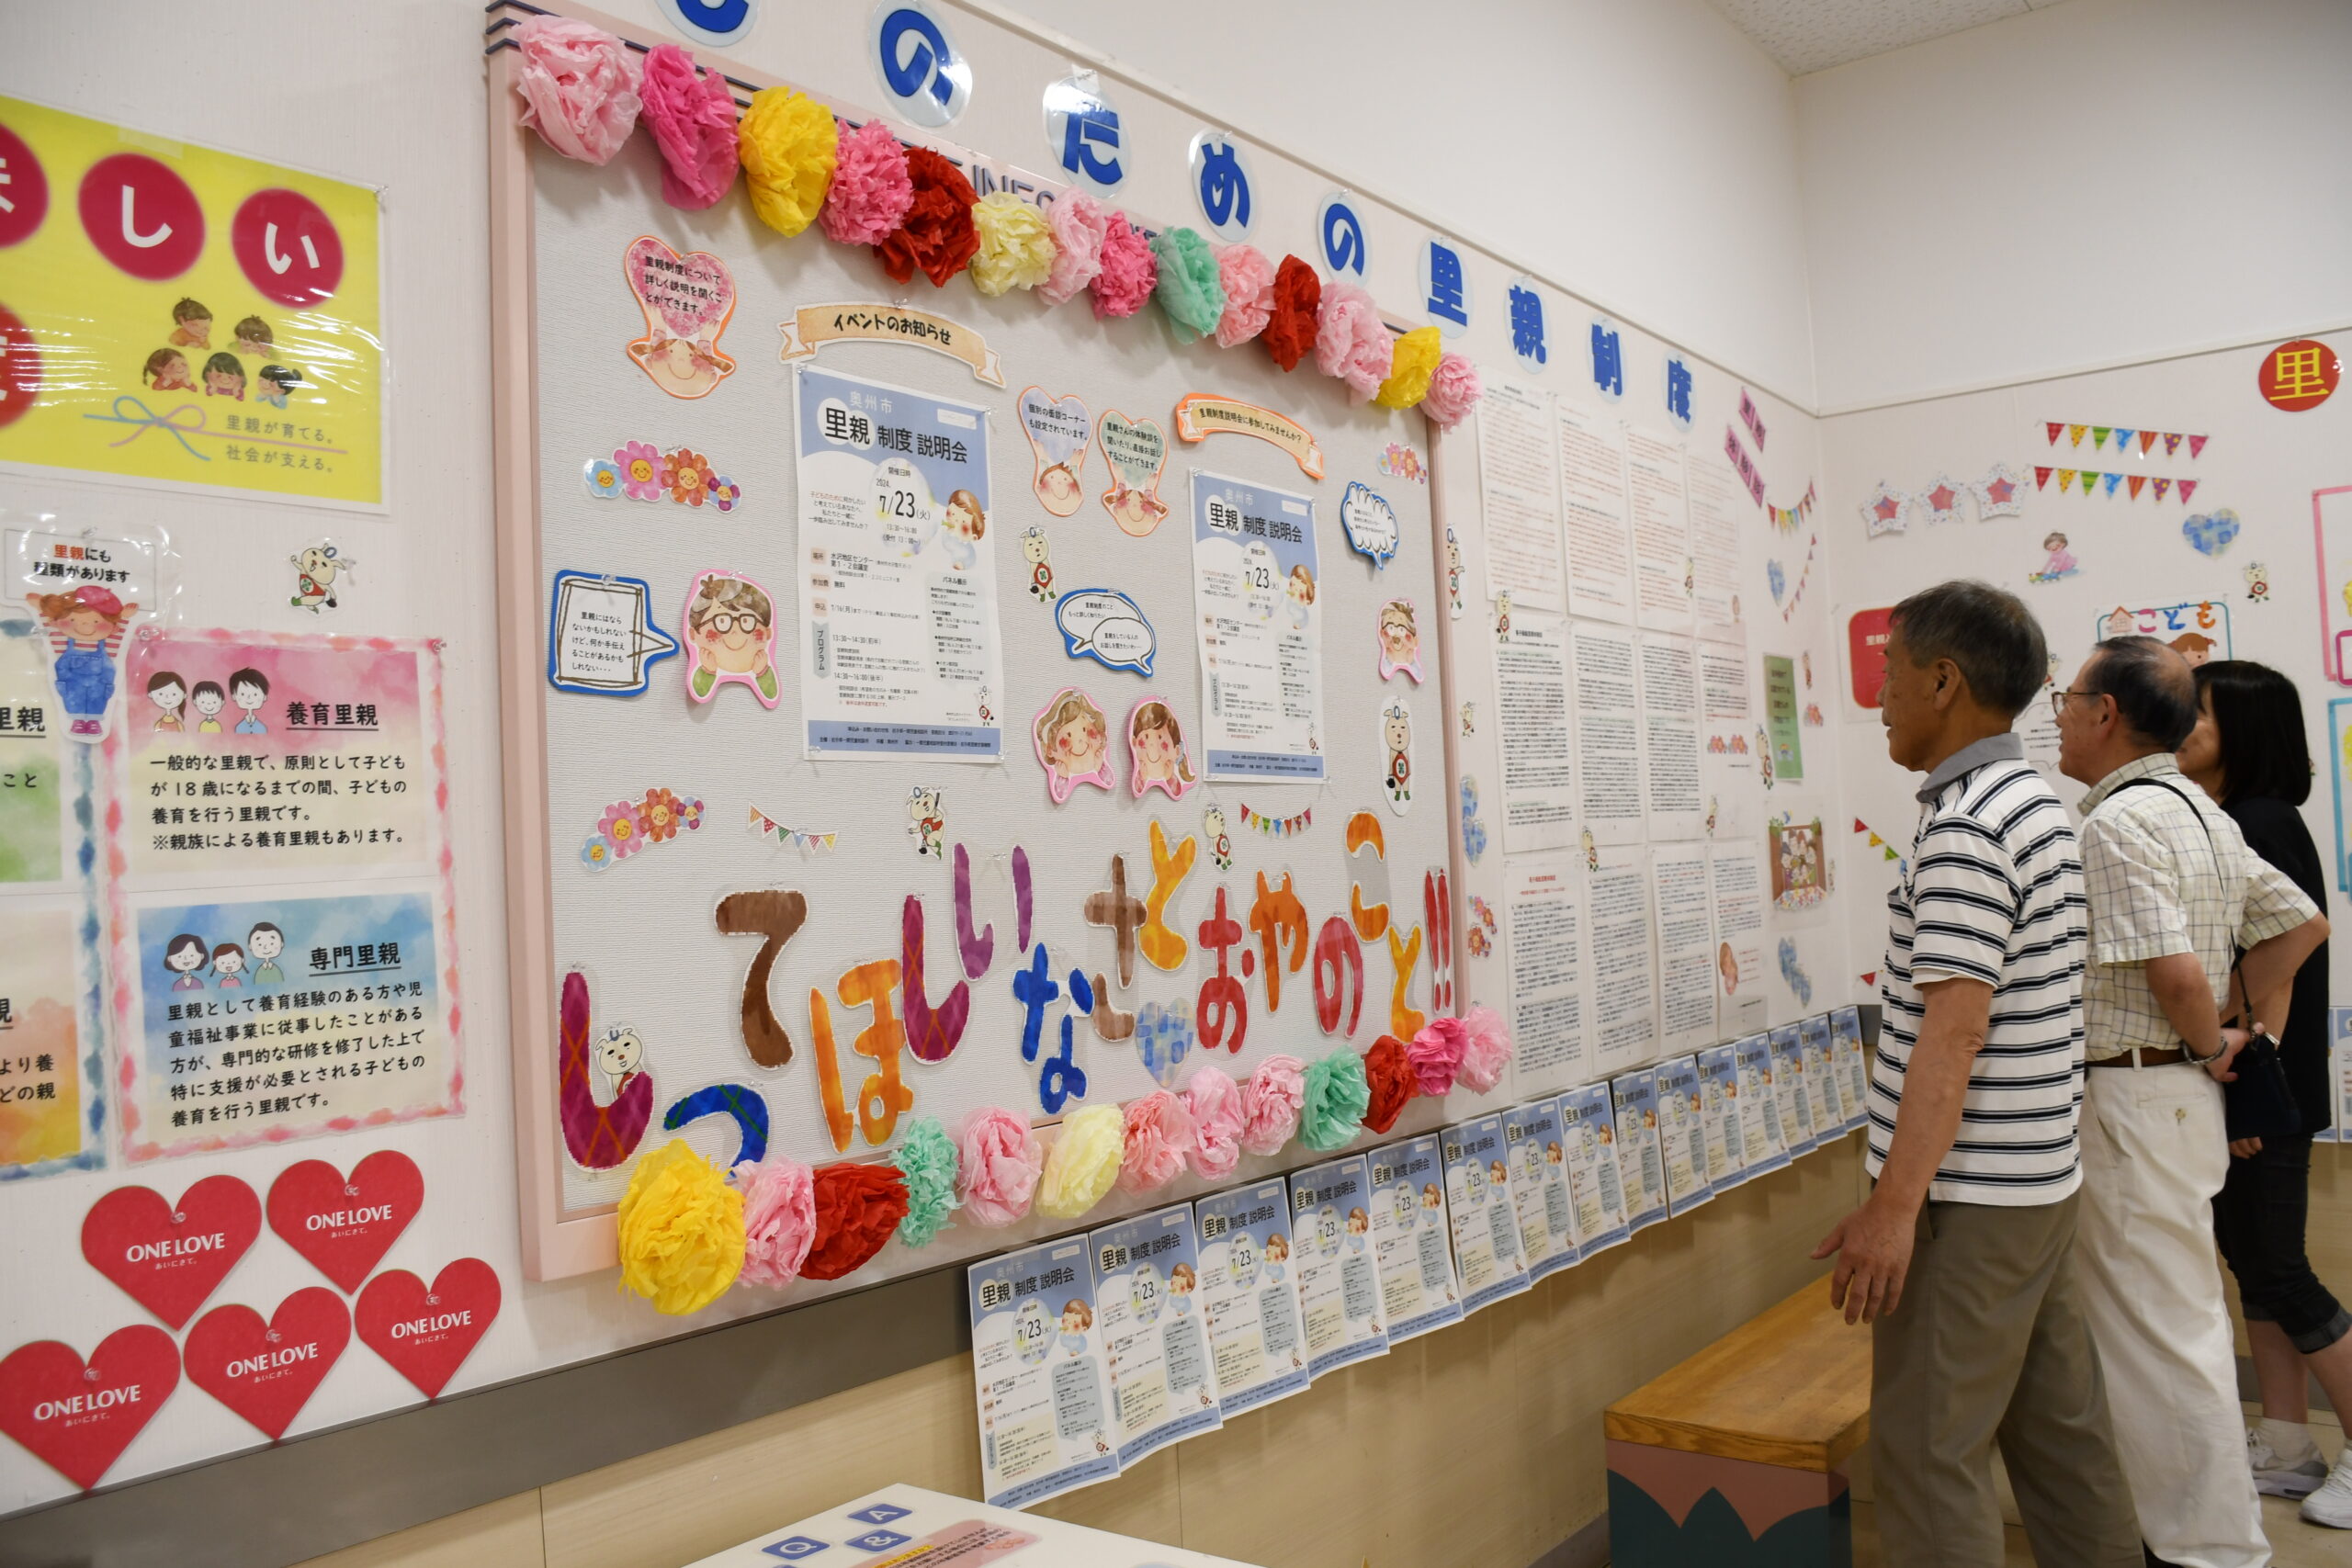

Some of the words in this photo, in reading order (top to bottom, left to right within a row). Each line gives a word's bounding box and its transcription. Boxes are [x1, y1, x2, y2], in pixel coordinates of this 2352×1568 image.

[645, 255, 721, 285] 里親制度について
[645, 292, 704, 316] とができます。
[832, 313, 952, 346] イベントのお知らせ
[2269, 347, 2330, 402] 里
[850, 390, 893, 414] 奥州市
[226, 414, 334, 445] 里親が育てる。
[825, 407, 870, 446] 里親
[877, 424, 913, 454] 制度
[917, 432, 967, 464] 説明会
[1028, 419, 1088, 441] も設定されています。
[226, 444, 334, 473] 社会が支える。
[1210, 502, 1239, 532] 里親
[54, 544, 111, 563] 里親にも
[580, 611, 623, 626] 里親にはなら
[2137, 600, 2216, 633] こども
[571, 624, 627, 637] ないかもしれない
[571, 636, 626, 651] けど、何か手伝え
[571, 649, 624, 663] ることがあるかも
[286, 702, 379, 728] 養育里親
[150, 754, 406, 772] 一般的な里親で、原則として子ども
[151, 805, 311, 825] 養育を行う里親です。
[153, 828, 404, 851] ※親族による養育里親もあります。
[308, 942, 401, 969] 専門里親
[167, 980, 424, 1021] 里親として養育経験のある方や児
[168, 1006, 424, 1049] 童福祉事業に従事したことがある
[170, 1029, 425, 1074] 方が、専門的な研修を修了した上で
[171, 1055, 425, 1101] 特に支援が必要とされる子どもの
[172, 1091, 330, 1128] 養育を行う里親です。
[1102, 1247, 1128, 1271] 里親
[982, 1282, 1012, 1308] 里親
